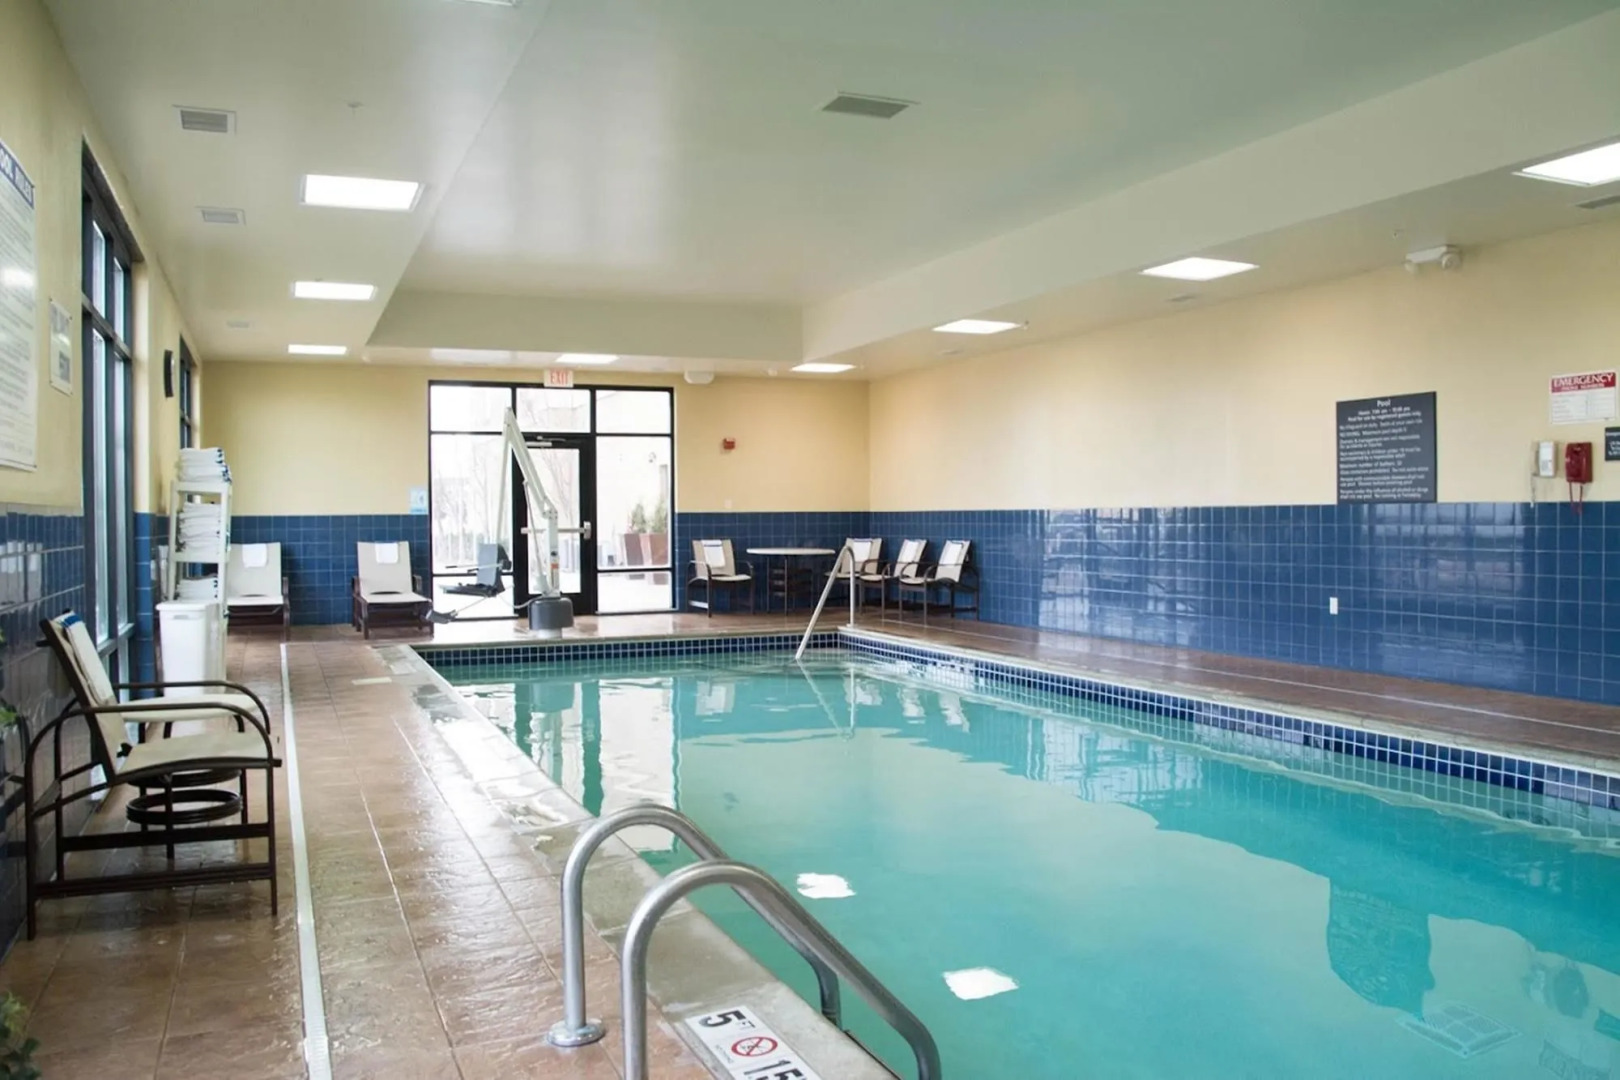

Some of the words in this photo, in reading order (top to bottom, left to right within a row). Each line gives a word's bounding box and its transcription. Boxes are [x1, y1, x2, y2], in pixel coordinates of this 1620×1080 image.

[550, 370, 568, 385] EXIT
[1553, 373, 1614, 388] EMERGENCY
[1376, 399, 1391, 407] Pool
[699, 1009, 747, 1028] 5
